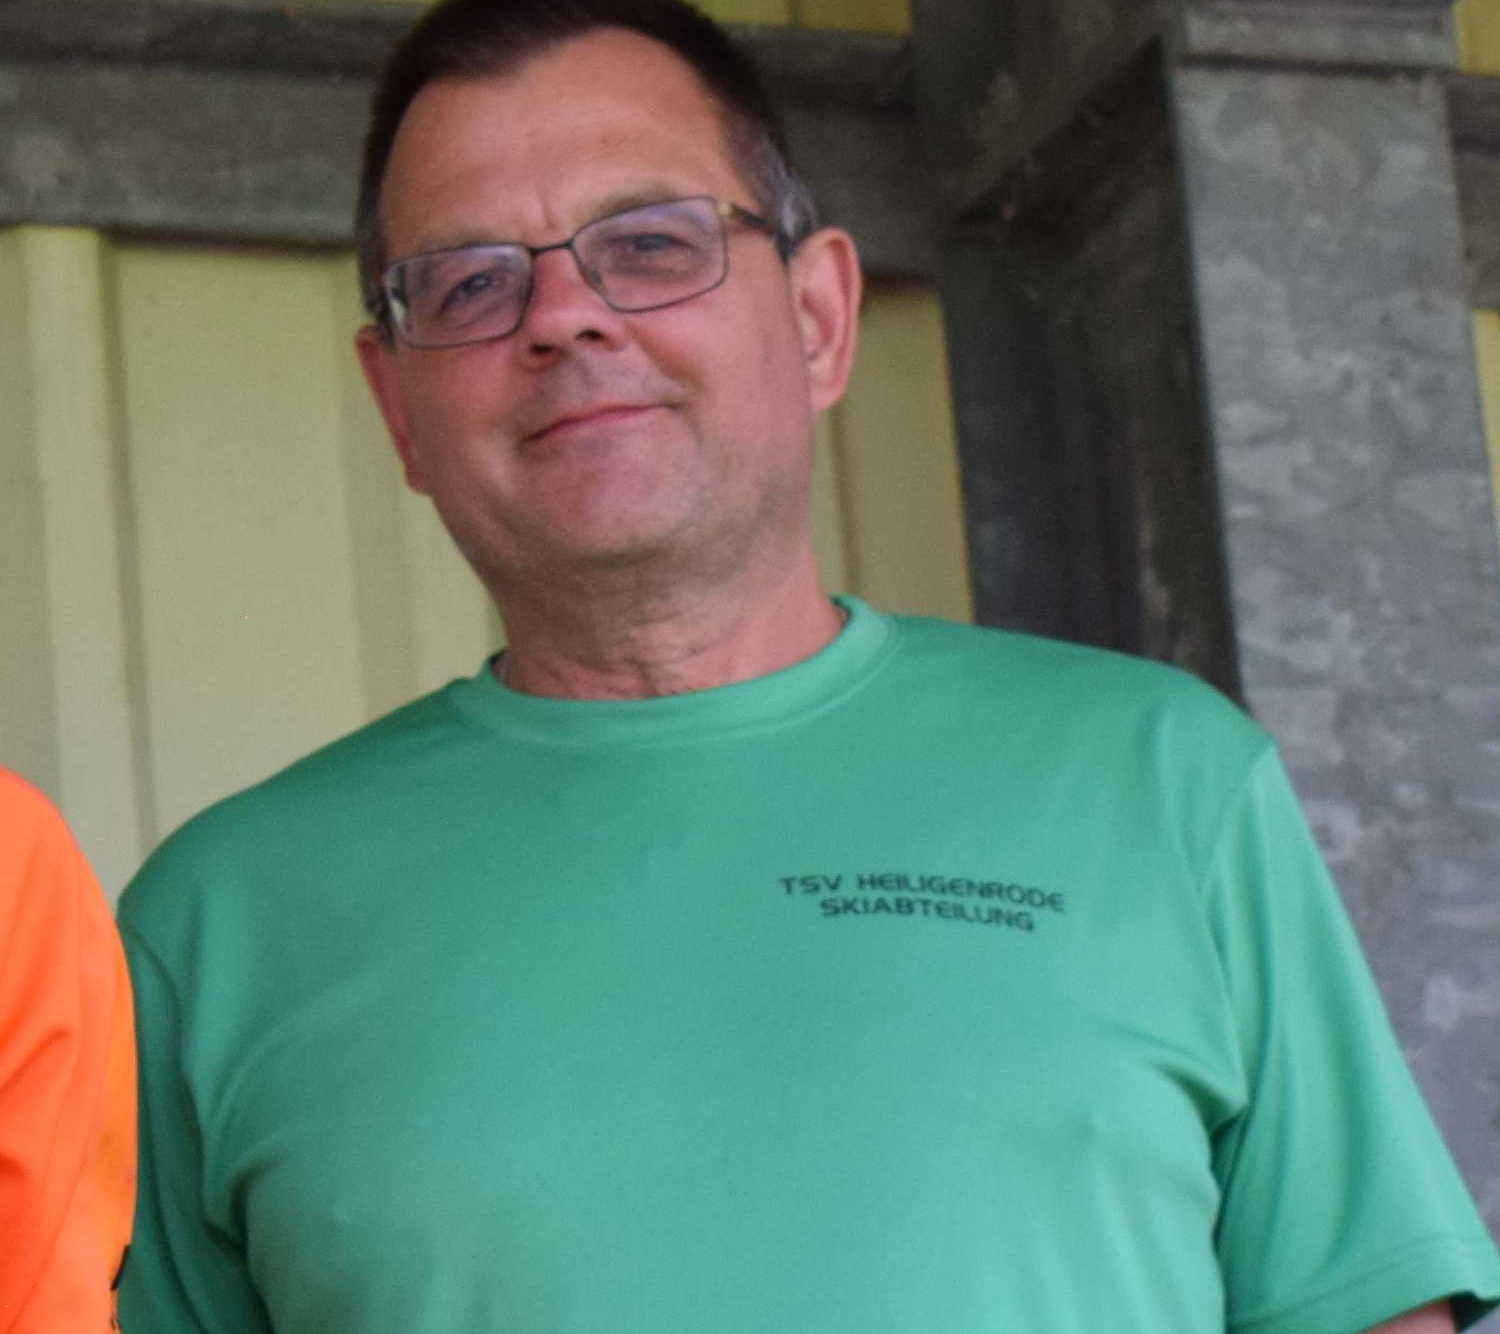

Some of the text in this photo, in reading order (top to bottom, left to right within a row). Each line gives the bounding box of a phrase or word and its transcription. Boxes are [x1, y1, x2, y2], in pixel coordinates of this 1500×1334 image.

[779, 872, 1066, 915] TSV HEILIGENRODE
[818, 895, 1035, 933] SKIABTEILUNG
